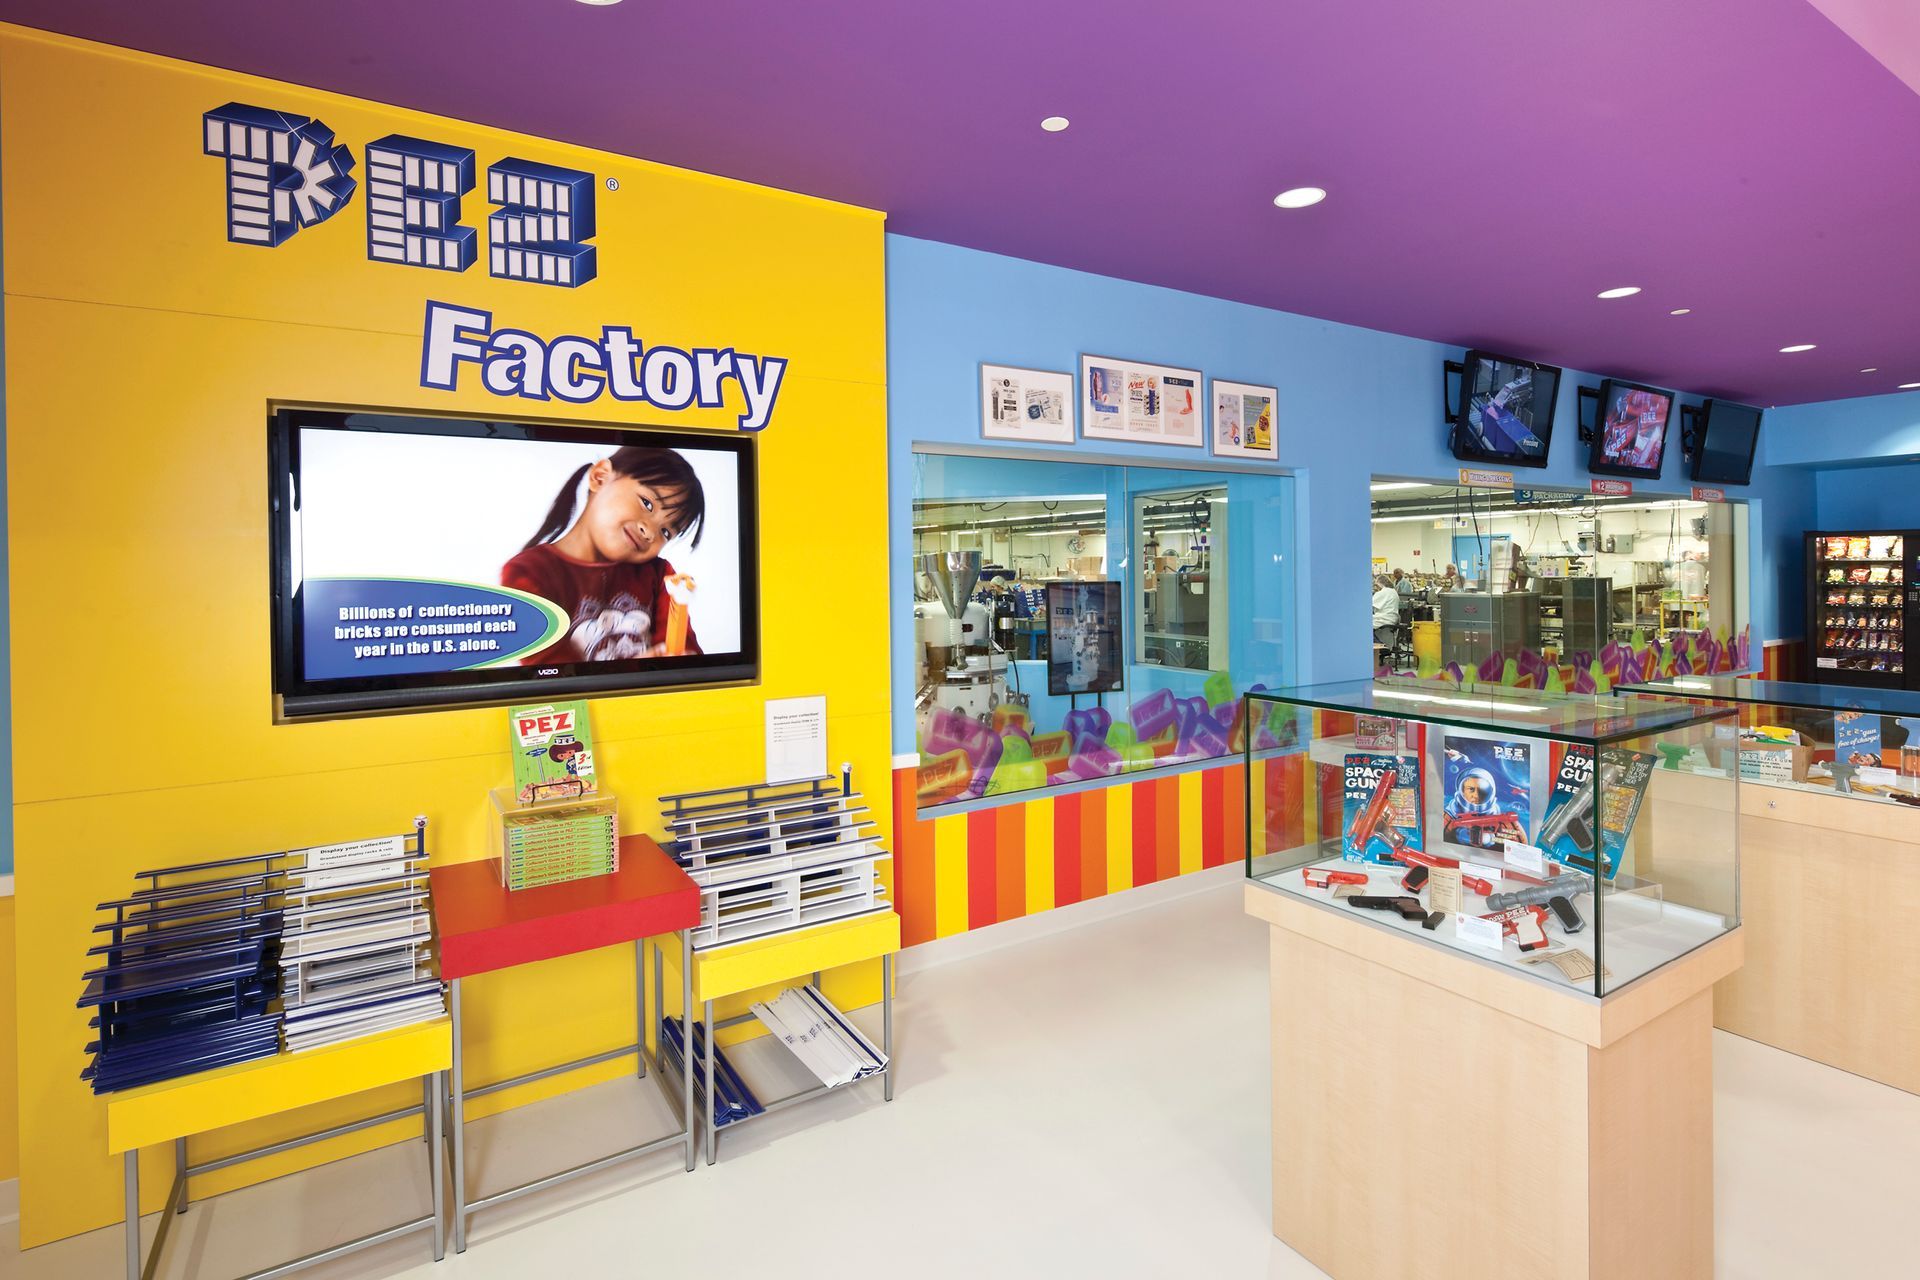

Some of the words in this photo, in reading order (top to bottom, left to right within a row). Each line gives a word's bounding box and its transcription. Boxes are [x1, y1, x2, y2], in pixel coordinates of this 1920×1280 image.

[203, 102, 597, 288] PEZ
[421, 299, 788, 432] Factory
[1600, 482, 1605, 490] 2
[1523, 490, 1531, 498] 3
[339, 606, 395, 620] Billions
[399, 606, 413, 618] of
[418, 603, 512, 617] confectionery
[335, 625, 381, 639] bricks
[384, 625, 407, 637] are
[411, 620, 481, 636] consumed
[484, 619, 516, 632] each
[354, 643, 387, 658] year
[390, 642, 404, 655] in
[407, 641, 430, 654] the
[433, 639, 457, 652] U.S.
[459, 638, 500, 650] alone.
[519, 713, 572, 736] PEZ
[1838, 740, 1849, 748] free
[1850, 737, 1857, 745] of
[1494, 746, 1523, 757] PEZ
[1564, 755, 1594, 770] SPA
[1345, 767, 1396, 778] SPAC
[1560, 767, 1592, 783] GU
[360, 840, 392, 848] collection!
